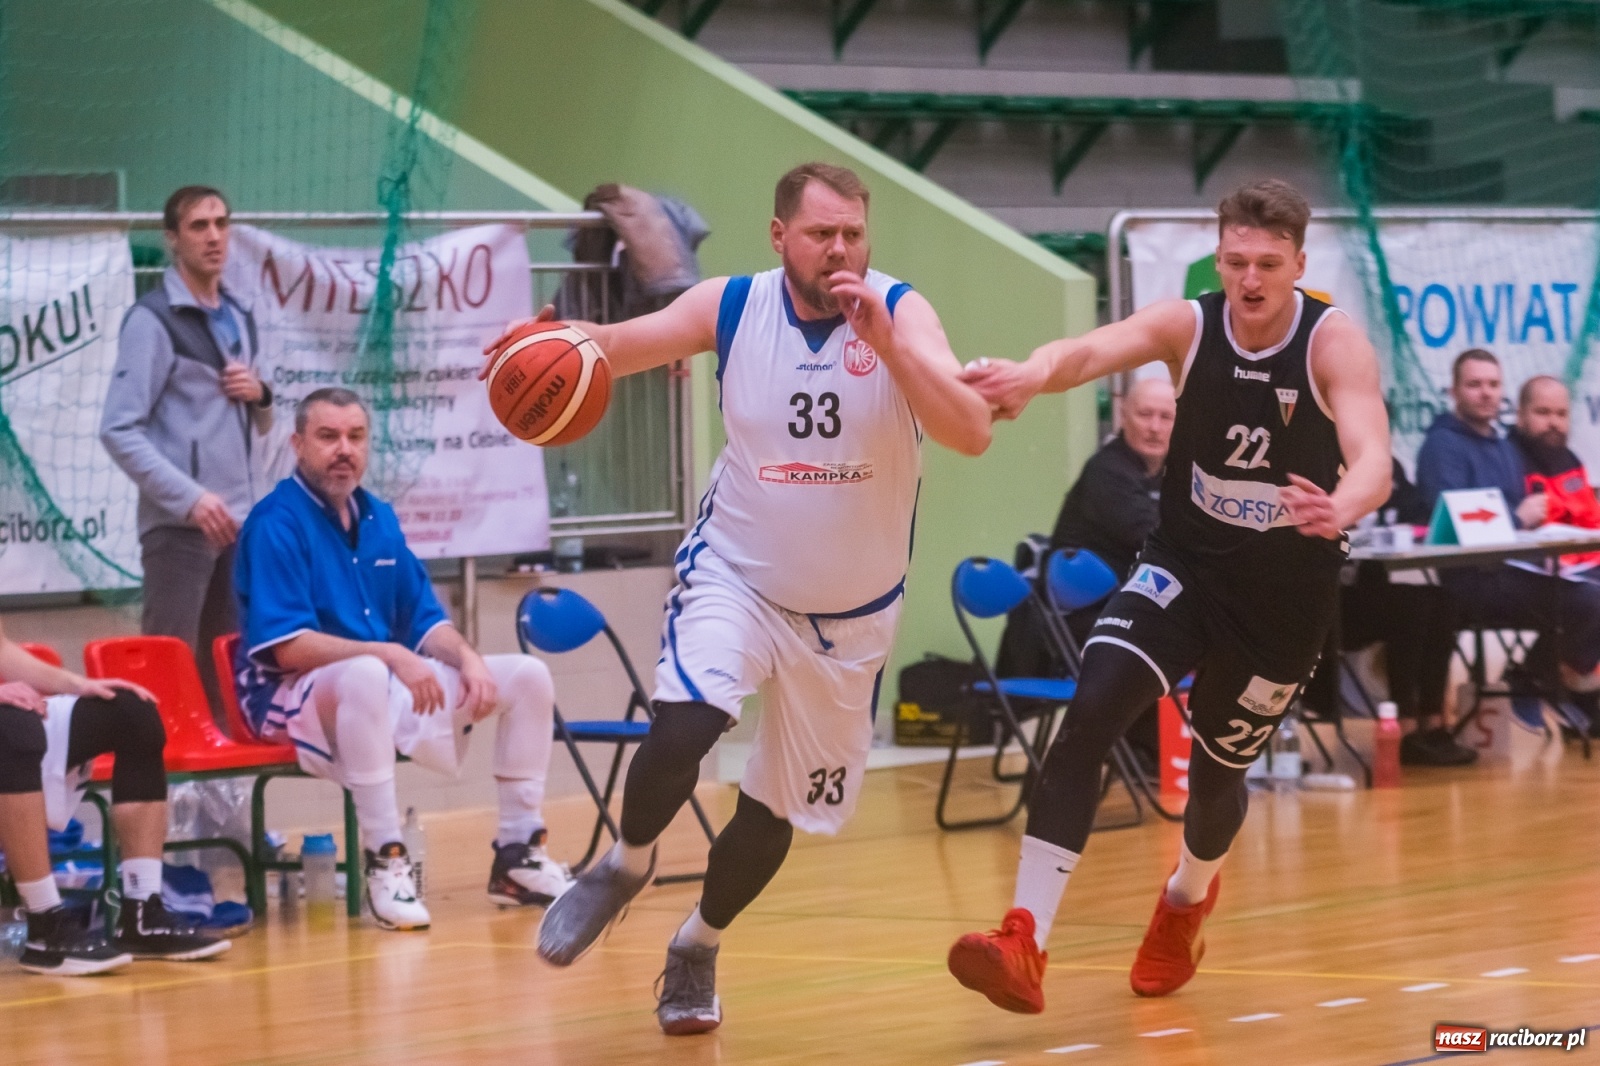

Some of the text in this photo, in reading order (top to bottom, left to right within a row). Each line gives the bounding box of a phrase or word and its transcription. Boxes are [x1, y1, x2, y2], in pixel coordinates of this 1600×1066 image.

[1392, 282, 1578, 348] POWIAT
[504, 370, 527, 395] FIBA
[1234, 365, 1271, 382] humme
[515, 374, 566, 432] molten
[788, 392, 842, 439] 33
[1224, 424, 1271, 469] 22
[790, 471, 862, 481] KAMPKA
[1214, 719, 1274, 756] 22
[807, 766, 846, 806] 33
